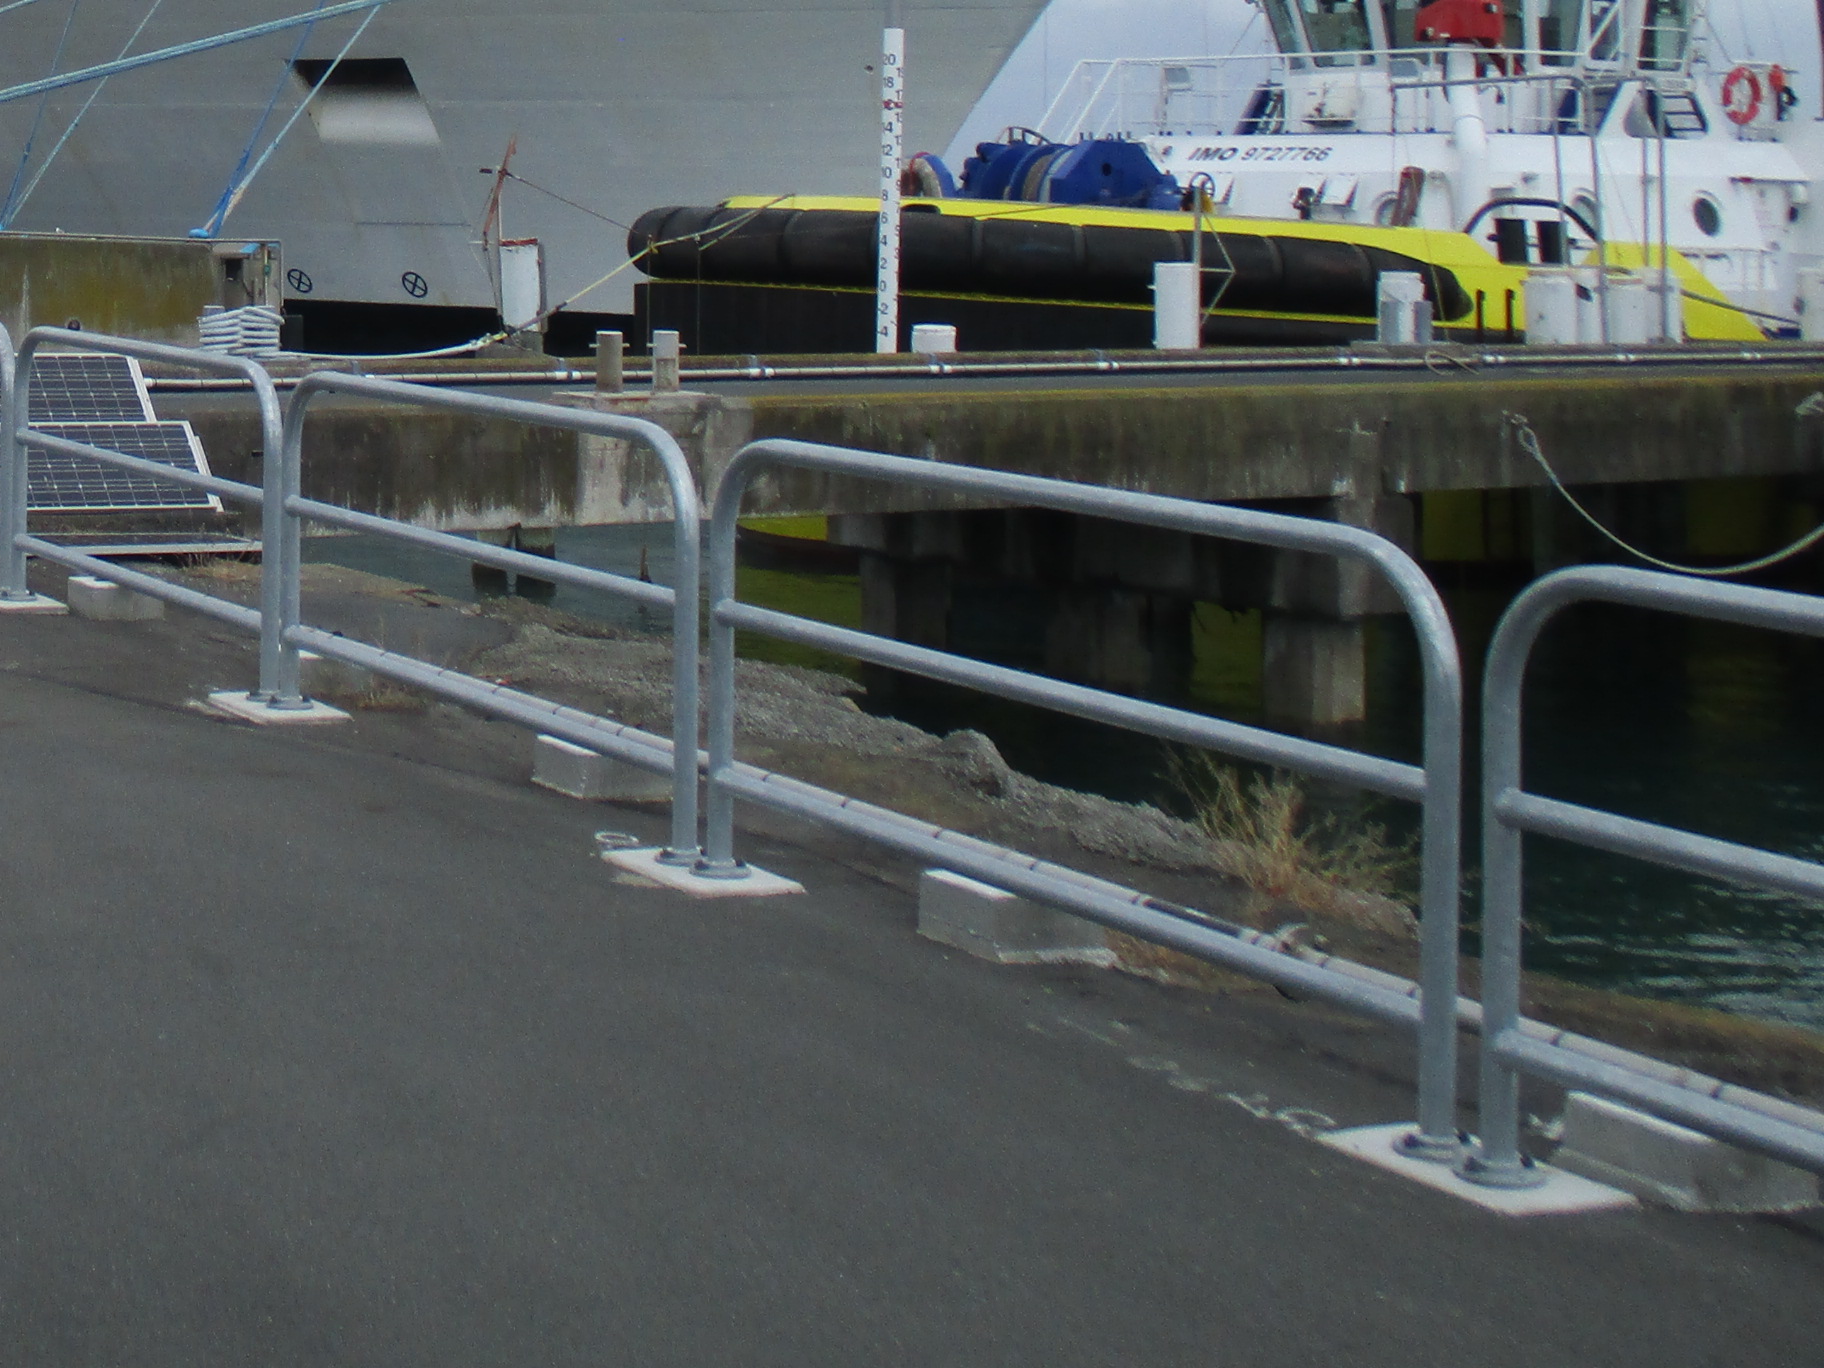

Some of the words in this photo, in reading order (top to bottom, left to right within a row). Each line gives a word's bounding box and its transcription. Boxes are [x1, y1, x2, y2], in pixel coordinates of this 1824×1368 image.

[1187, 146, 1239, 161] IMO
[1241, 146, 1334, 162] 9727766
[881, 188, 889, 202] 8
[880, 212, 888, 224] 6
[879, 235, 888, 247] 4
[880, 257, 888, 270] 2
[879, 280, 887, 292] 0
